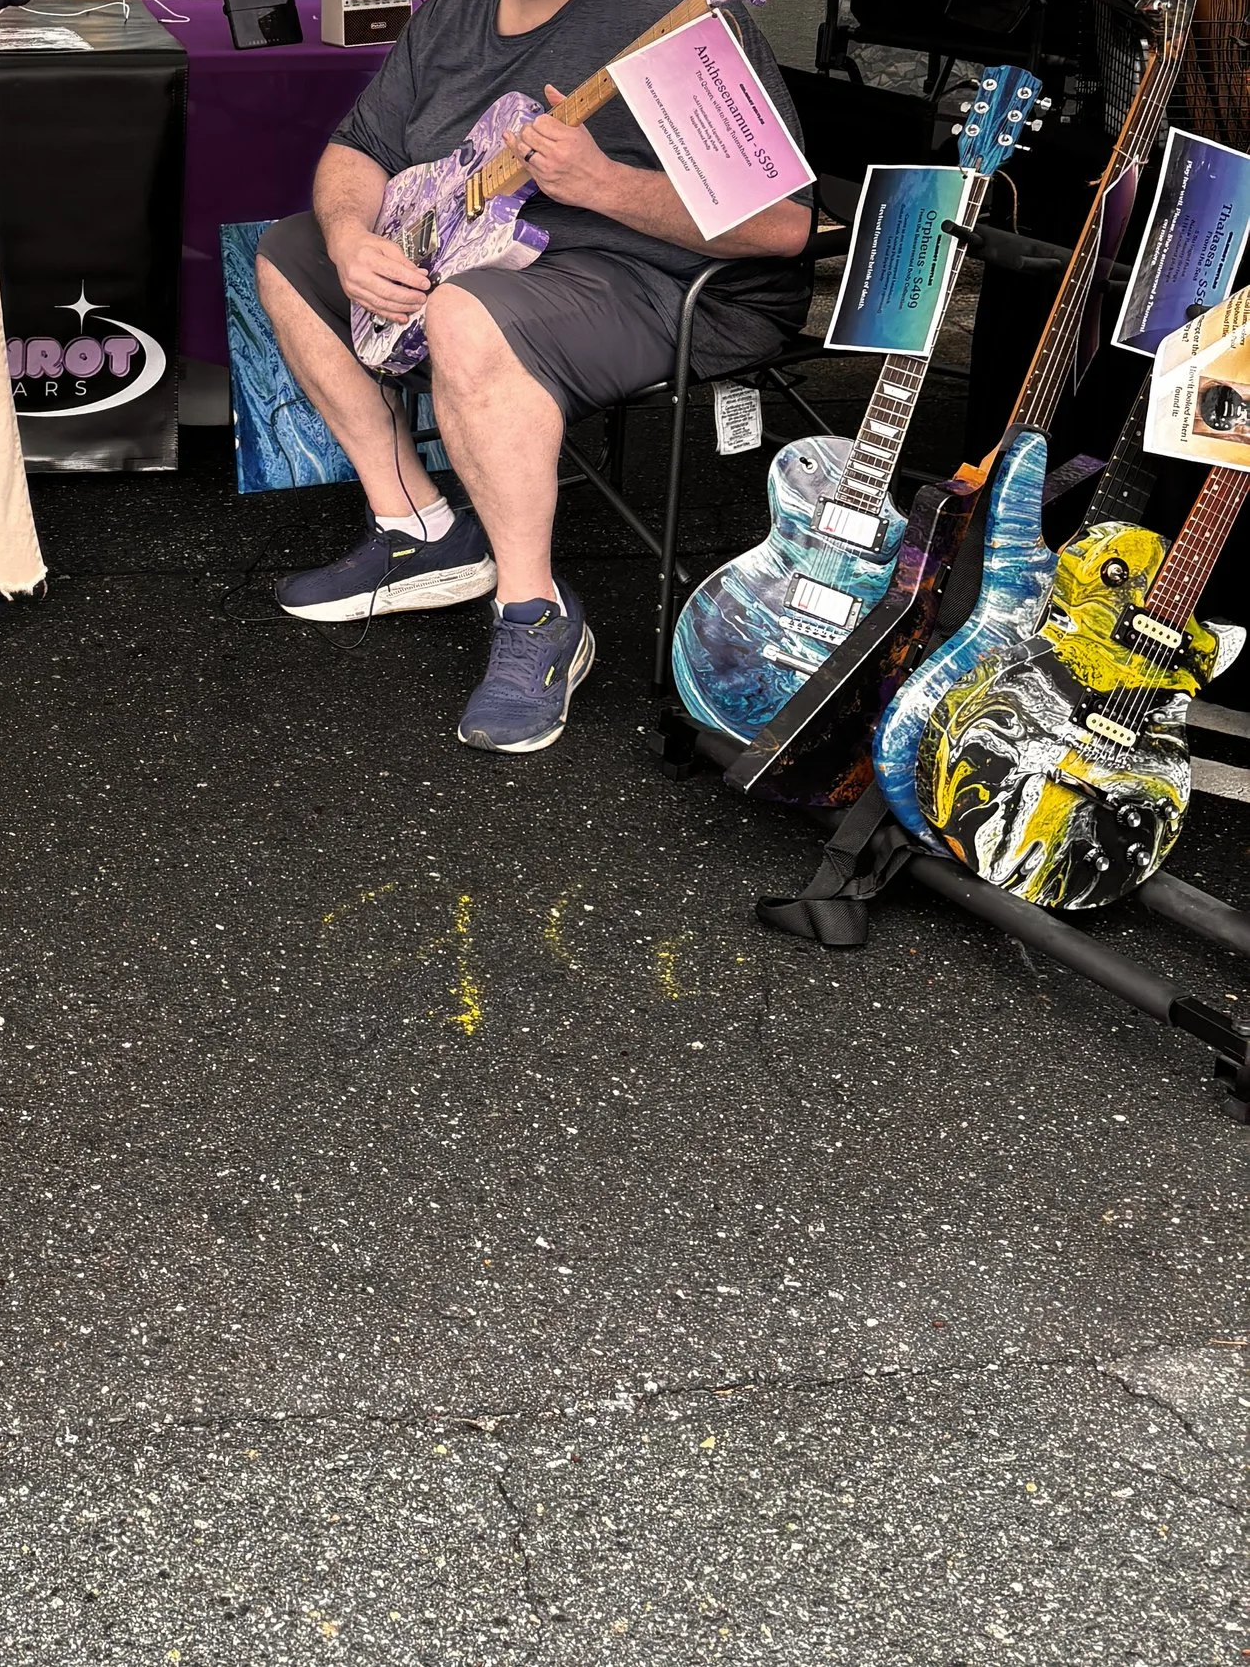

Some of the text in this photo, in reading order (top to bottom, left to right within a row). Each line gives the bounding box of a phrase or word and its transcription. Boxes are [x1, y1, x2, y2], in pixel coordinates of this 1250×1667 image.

[655, 96, 664, 108] not
[693, 41, 757, 144] Ankhesenamun
[694, 69, 705, 82] The
[711, 99, 722, 113] wife
[720, 117, 733, 132] King
[659, 105, 682, 139] responsible
[659, 123, 669, 135] you
[664, 133, 676, 146] buy
[677, 136, 686, 146] for
[687, 154, 706, 181] potential
[1182, 159, 1193, 176] Play
[1180, 176, 1189, 189] her
[870, 230, 880, 249] from
[914, 208, 937, 268] Orpheus
[1201, 230, 1212, 253] From
[1203, 201, 1233, 269] Thalassa
[868, 248, 876, 261] the
[1196, 252, 1206, 266] the
[864, 260, 874, 281] brink
[1190, 343, 1199, 356] the
[1171, 385, 1183, 408] found
[1182, 390, 1194, 416] looked
[1179, 416, 1190, 437] when
